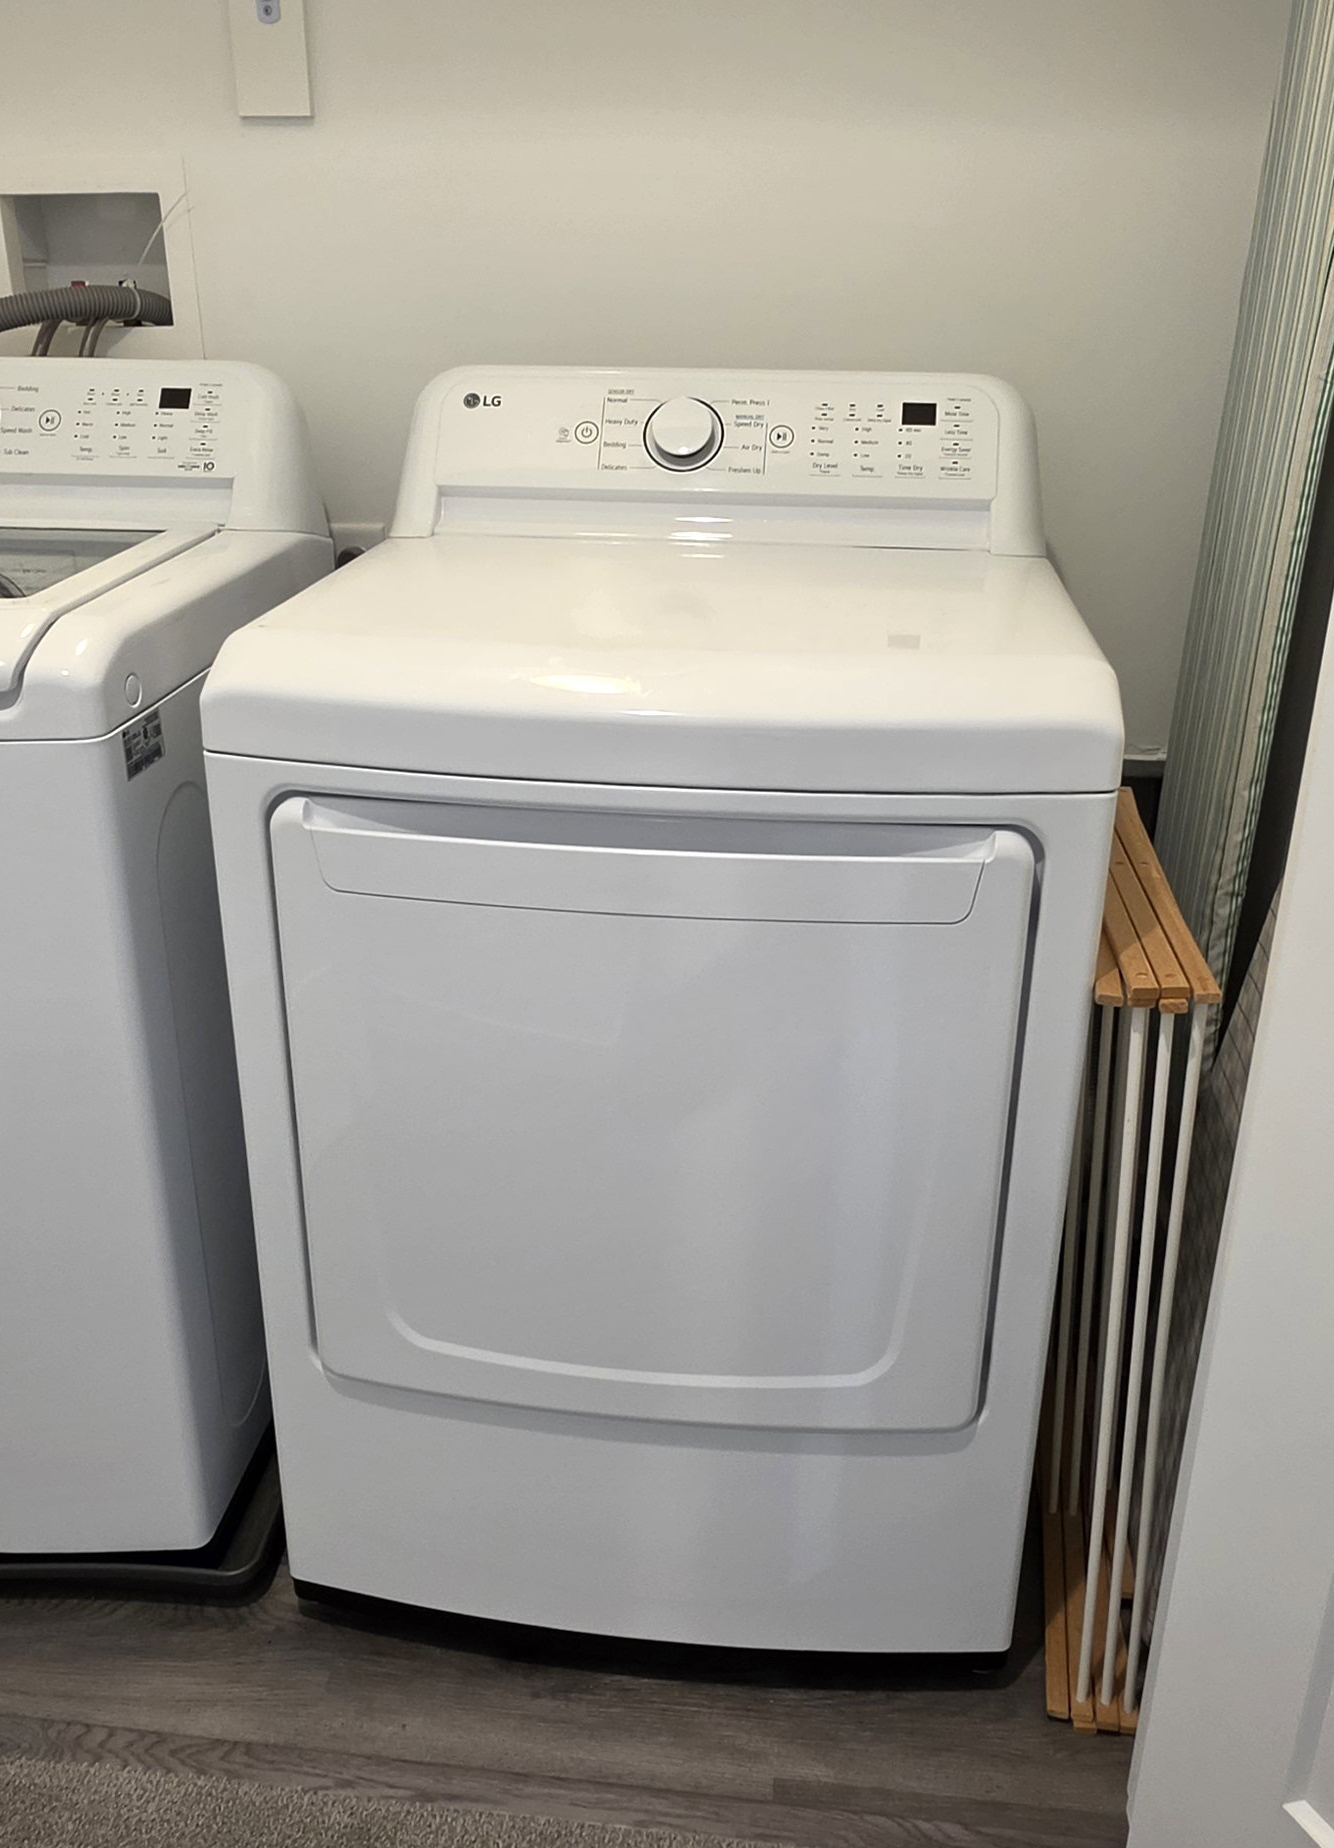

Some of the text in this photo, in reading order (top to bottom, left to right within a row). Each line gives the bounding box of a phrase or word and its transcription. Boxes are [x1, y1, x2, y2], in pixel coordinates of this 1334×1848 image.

[17, 385, 39, 393] Bedding
[483, 394, 502, 407] LG
[624, 418, 638, 426] Duty
[734, 421, 764, 429] Speed Dry
[603, 441, 627, 449] Bedding
[751, 443, 763, 451] Dry
[601, 463, 627, 471] Delicates
[728, 466, 762, 475] Freshen Up
